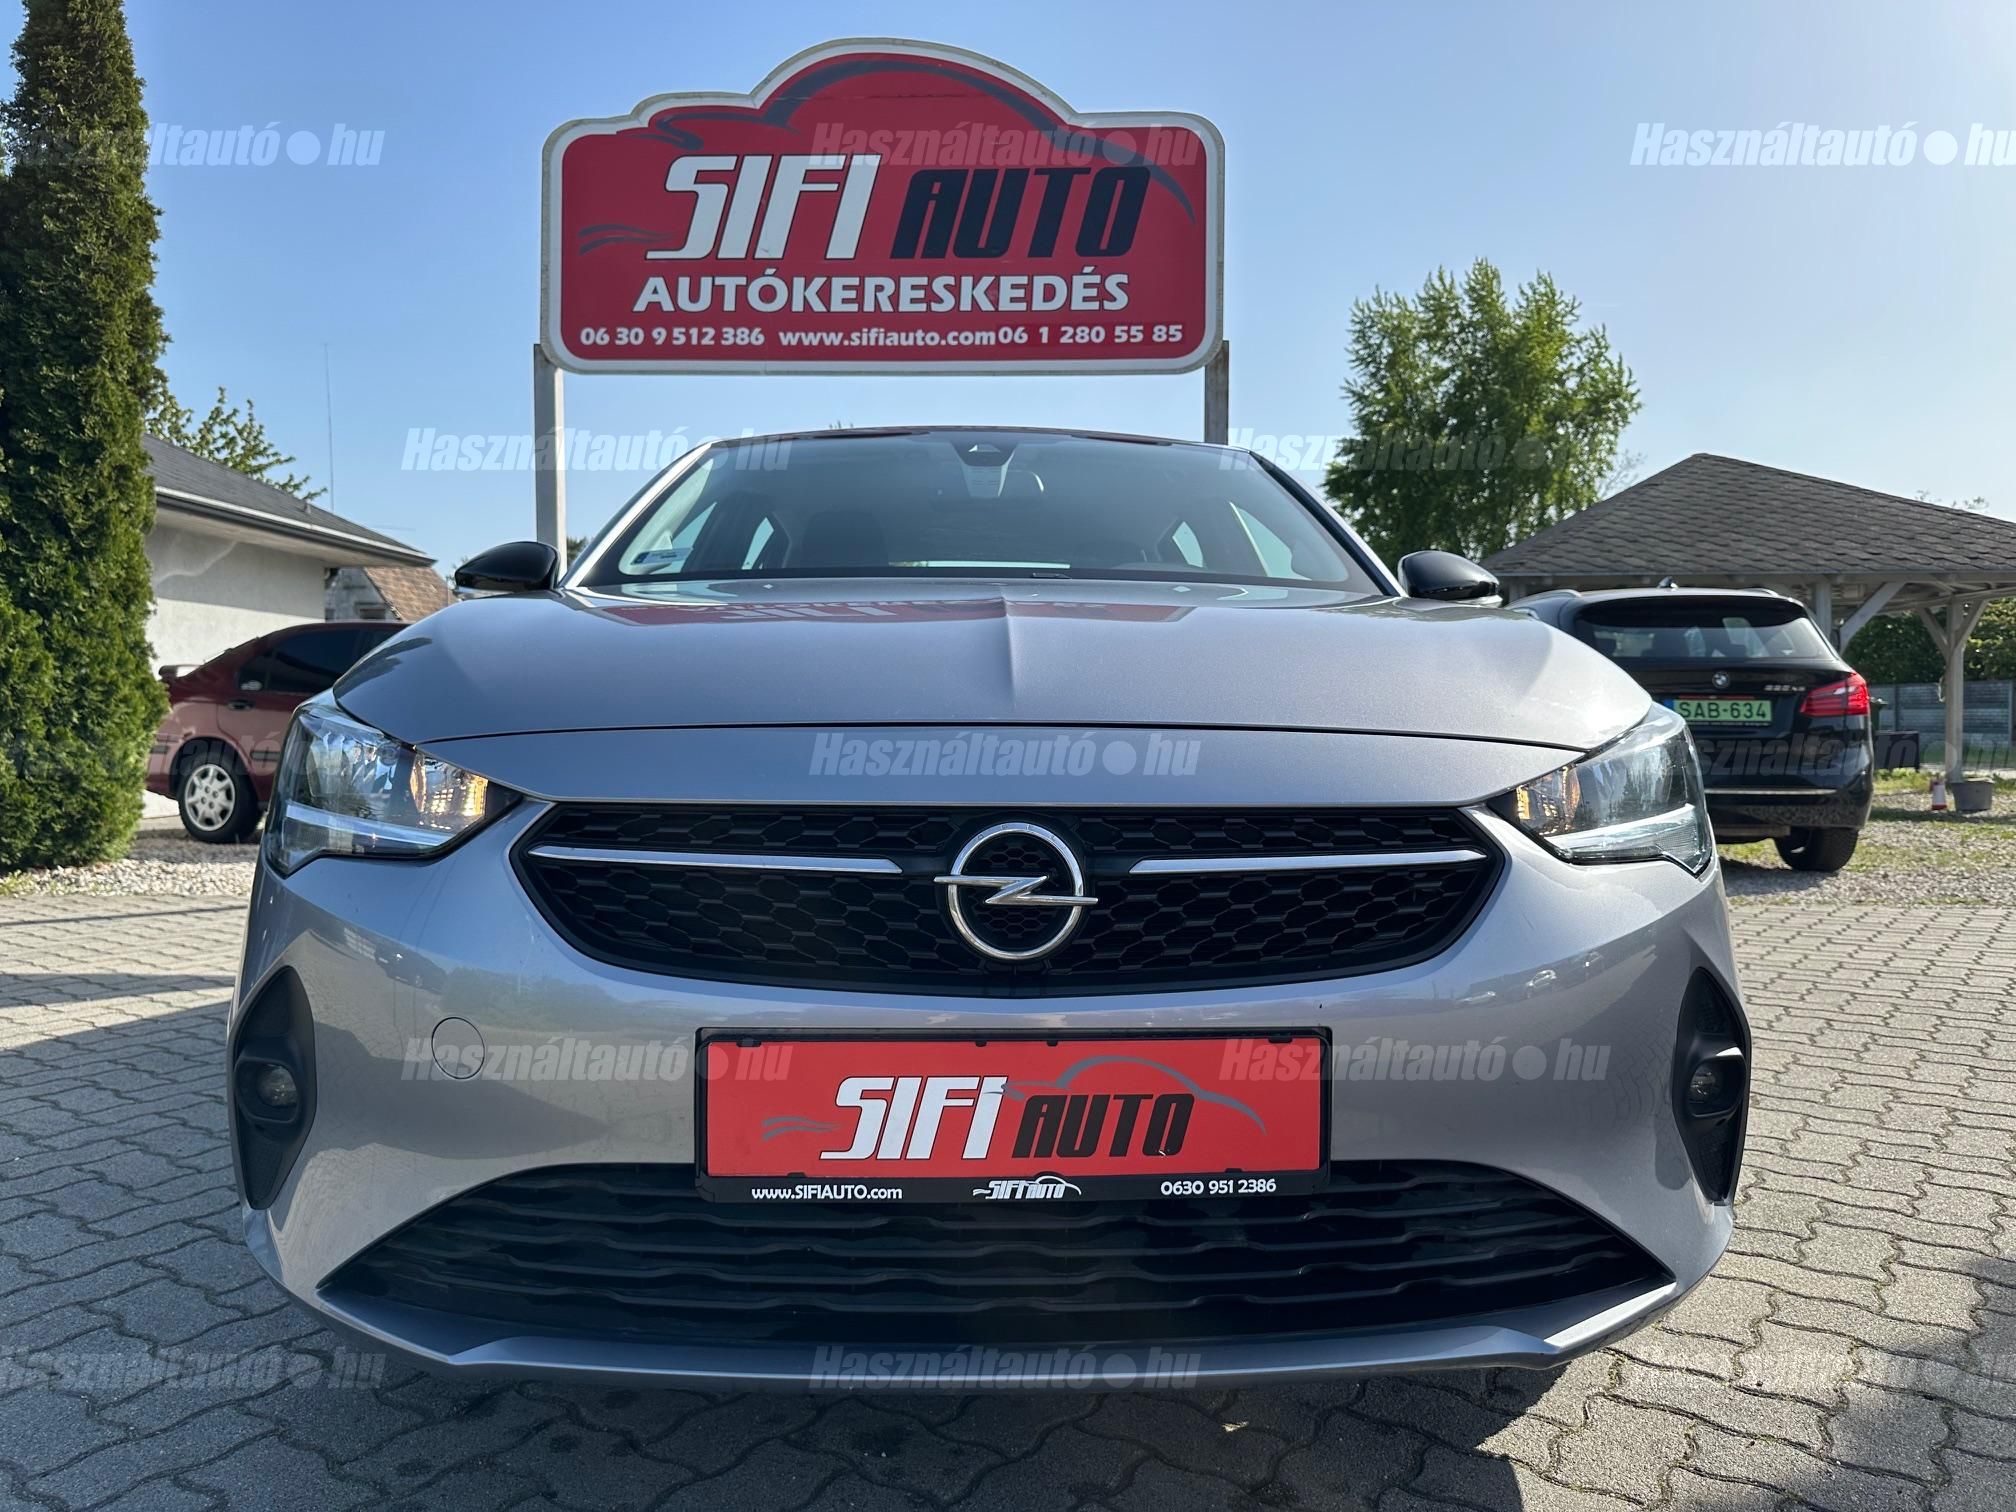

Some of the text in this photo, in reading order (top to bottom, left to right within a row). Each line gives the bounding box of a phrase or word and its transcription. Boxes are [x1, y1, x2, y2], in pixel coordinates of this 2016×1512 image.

[645, 153, 1151, 260] SIFI AUTO
[632, 265, 1130, 313] AUTÓKERESKEDÉS
[580, 324, 1183, 346] 06 30 9 512 386 www.sifiauto.com 06 1 280 55 85
[1678, 702, 1767, 719] SAB-634
[819, 1075, 1195, 1160] SIFI AUTO
[751, 1184, 903, 1200] www.SIFIAUTO.com
[1160, 1178, 1277, 1196] 0630 951 2386
